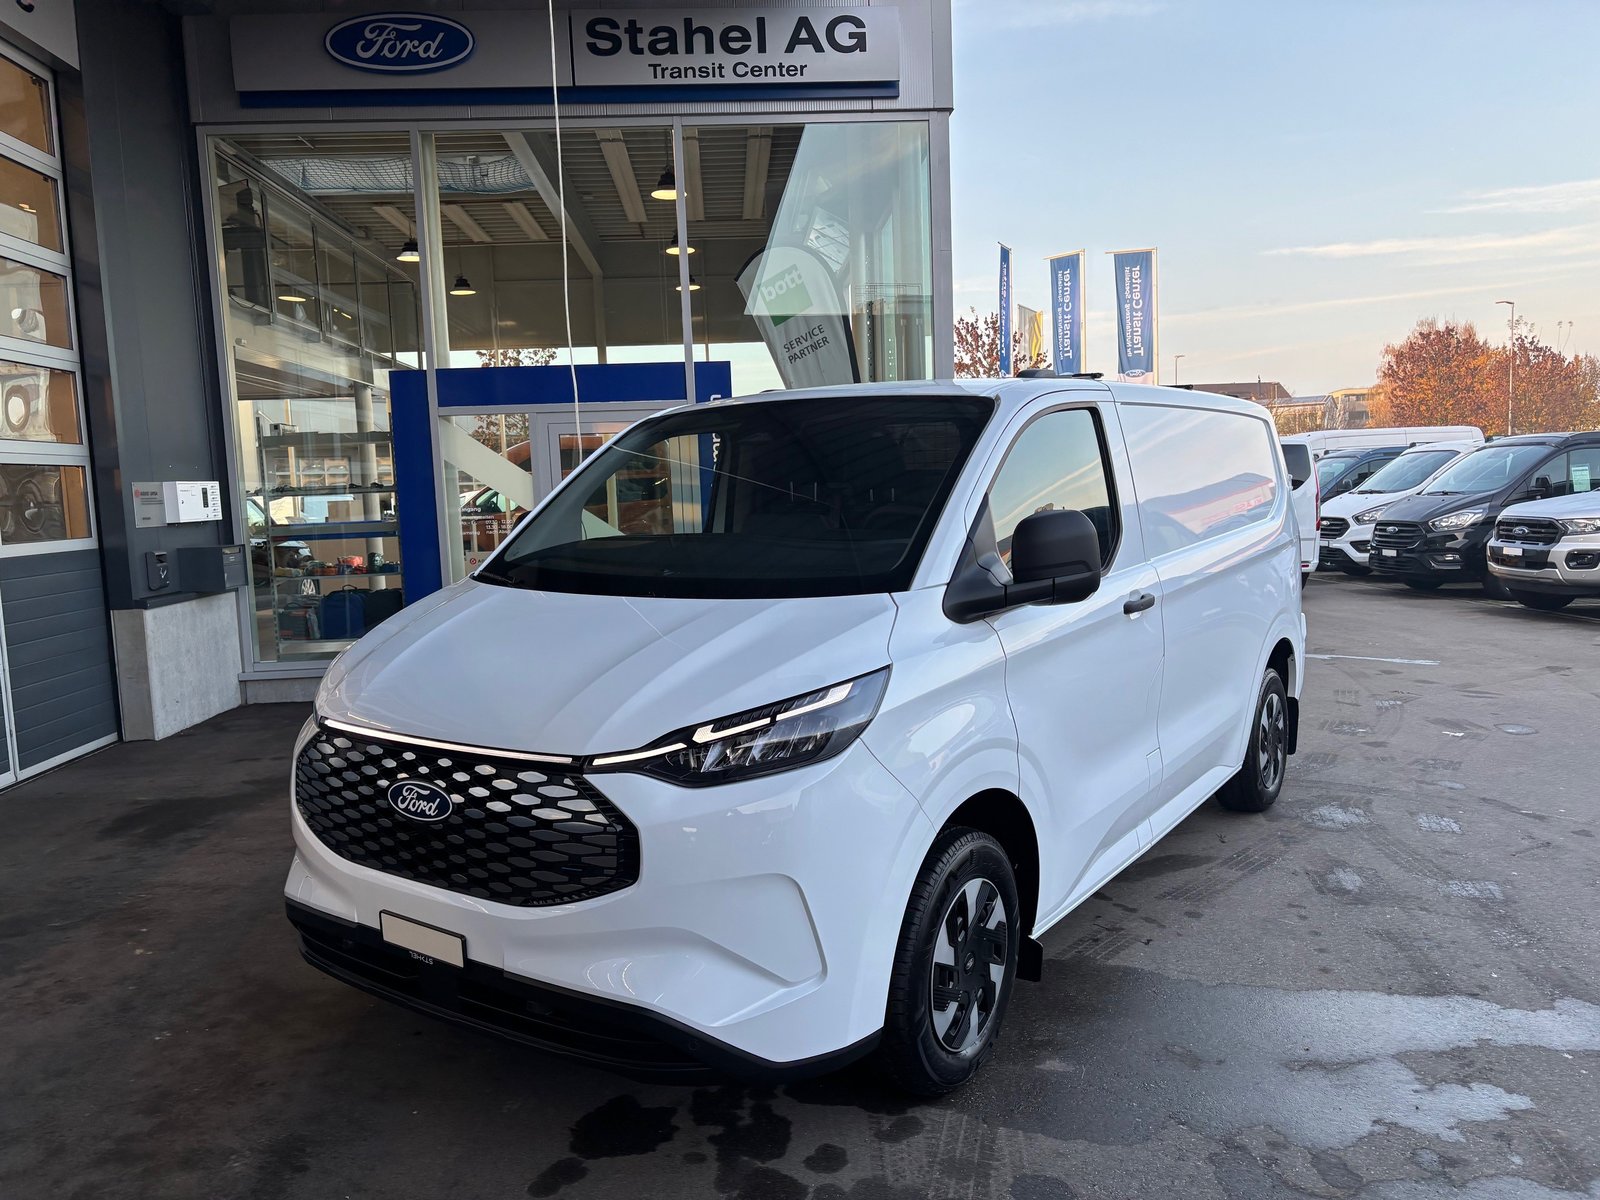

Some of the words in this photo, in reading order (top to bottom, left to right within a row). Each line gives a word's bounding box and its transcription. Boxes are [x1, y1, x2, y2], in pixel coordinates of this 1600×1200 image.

[356, 22, 445, 59] Ford
[585, 16, 767, 56] Stahel
[784, 15, 867, 53] AG
[648, 62, 725, 80] Transit
[732, 62, 808, 79] Center
[761, 269, 804, 302] bott
[783, 324, 825, 353] SERVICE
[787, 336, 830, 364] PARTNER
[398, 785, 441, 817] Ford
